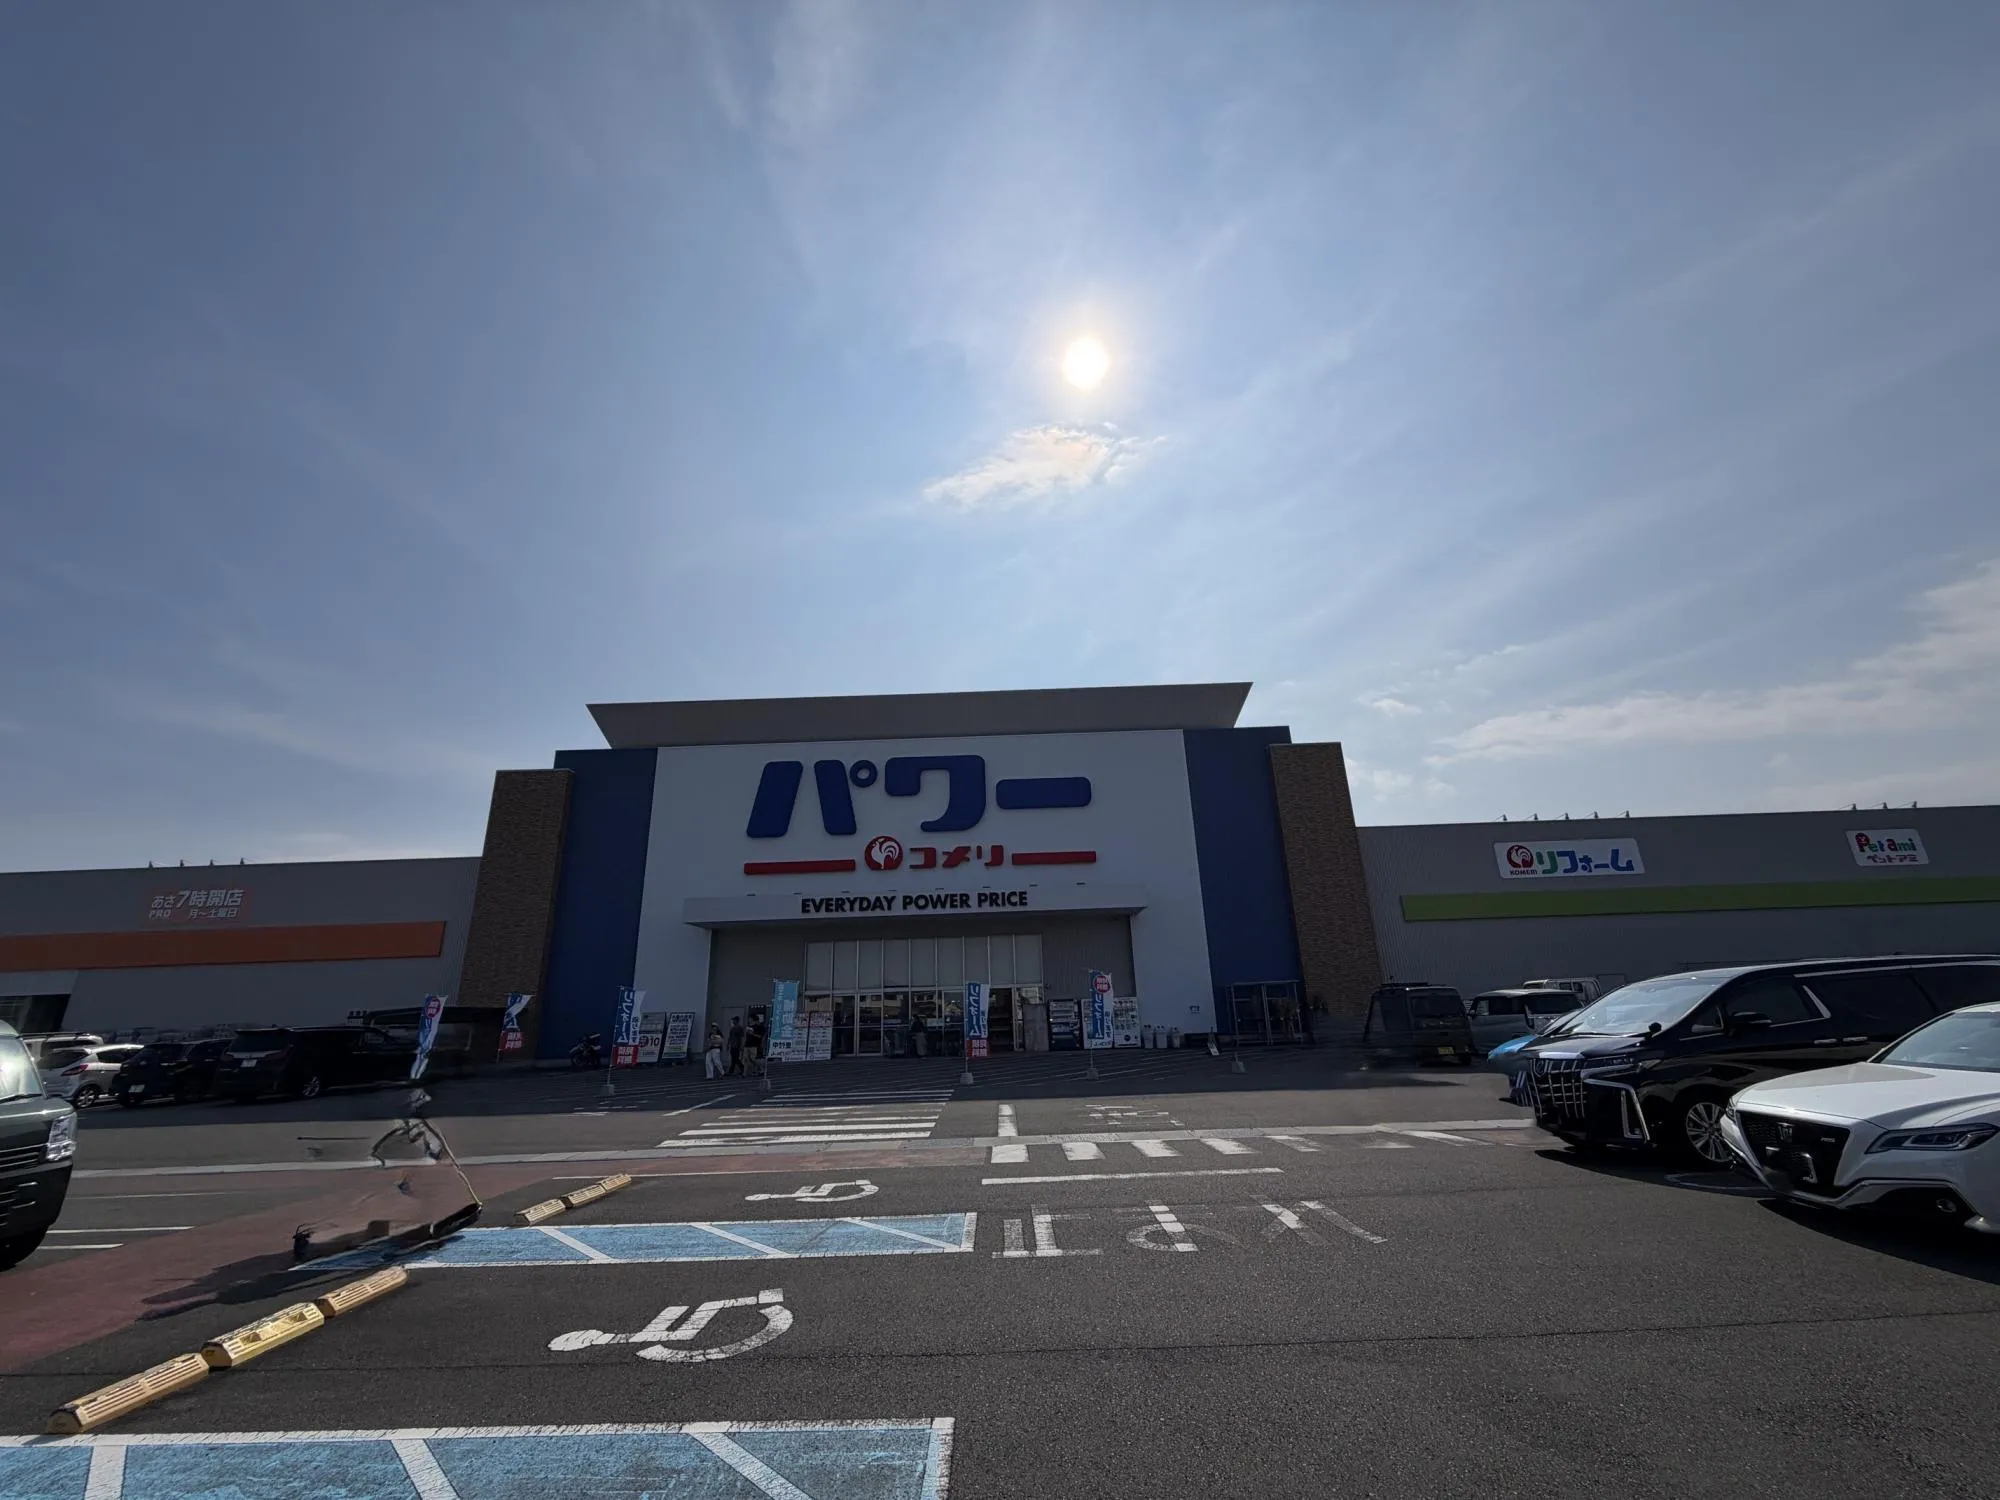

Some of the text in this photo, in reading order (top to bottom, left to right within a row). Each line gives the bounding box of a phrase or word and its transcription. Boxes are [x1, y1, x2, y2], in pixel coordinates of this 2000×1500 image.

[747, 755, 1092, 838] パワー
[909, 845, 1005, 869] コメリ
[1536, 849, 1635, 875] リフォーム
[802, 890, 1028, 914] EVERYDAY POWER PRICE
